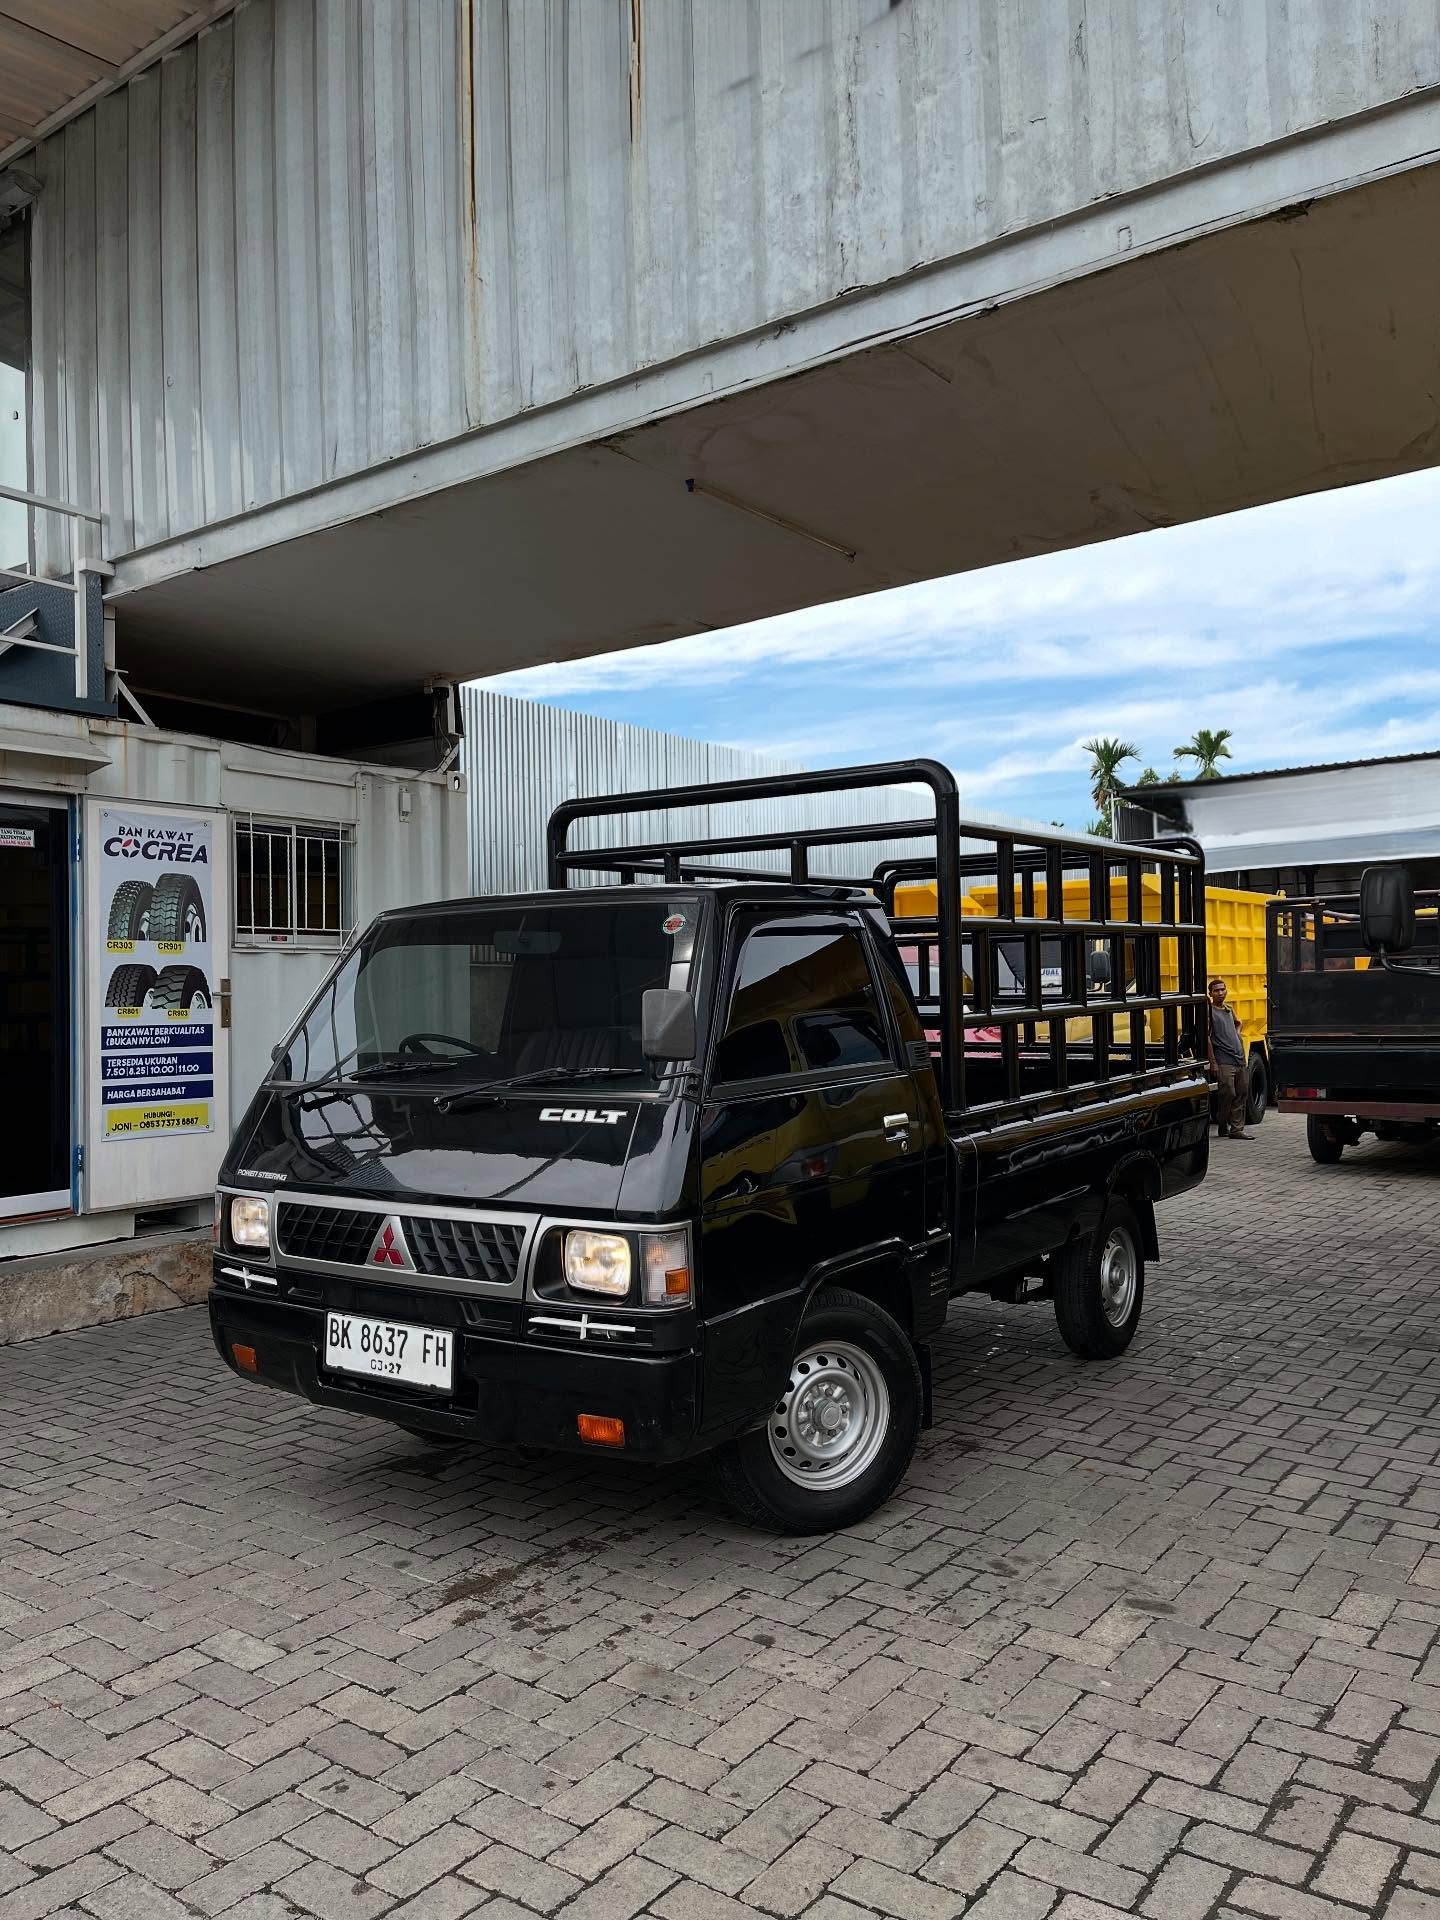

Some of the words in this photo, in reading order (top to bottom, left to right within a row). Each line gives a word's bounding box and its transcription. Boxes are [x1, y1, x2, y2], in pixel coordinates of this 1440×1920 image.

[118, 826, 142, 837] BAN
[147, 829, 193, 841] KAWAT
[103, 837, 208, 863] COCREA
[107, 941, 133, 949] CR303
[157, 942, 182, 950] CR901
[107, 1028, 124, 1037] BAN
[125, 1028, 153, 1036] KAWAT
[154, 1026, 205, 1035] BERKUALITAS
[106, 1037, 138, 1046] (BUKAN
[138, 1036, 170, 1045] NYLON)
[107, 1058, 144, 1067] TERSEDIA
[144, 1056, 178, 1065] UKURAN
[106, 1068, 125, 1076] 7.50
[128, 1067, 146, 1075] 8.25
[150, 1066, 175, 1074] 10.00
[178, 1064, 200, 1072] 11.00
[107, 1090, 136, 1099] HARGA
[136, 1087, 186, 1097] BERSAHABAT
[539, 1108, 628, 1124] COLT
[112, 1122, 132, 1131] JONI
[237, 1169, 258, 1177] POWER
[258, 1171, 288, 1181] STEERING
[329, 1318, 352, 1349] BK
[360, 1323, 408, 1359] 8637
[422, 1333, 447, 1367] FH
